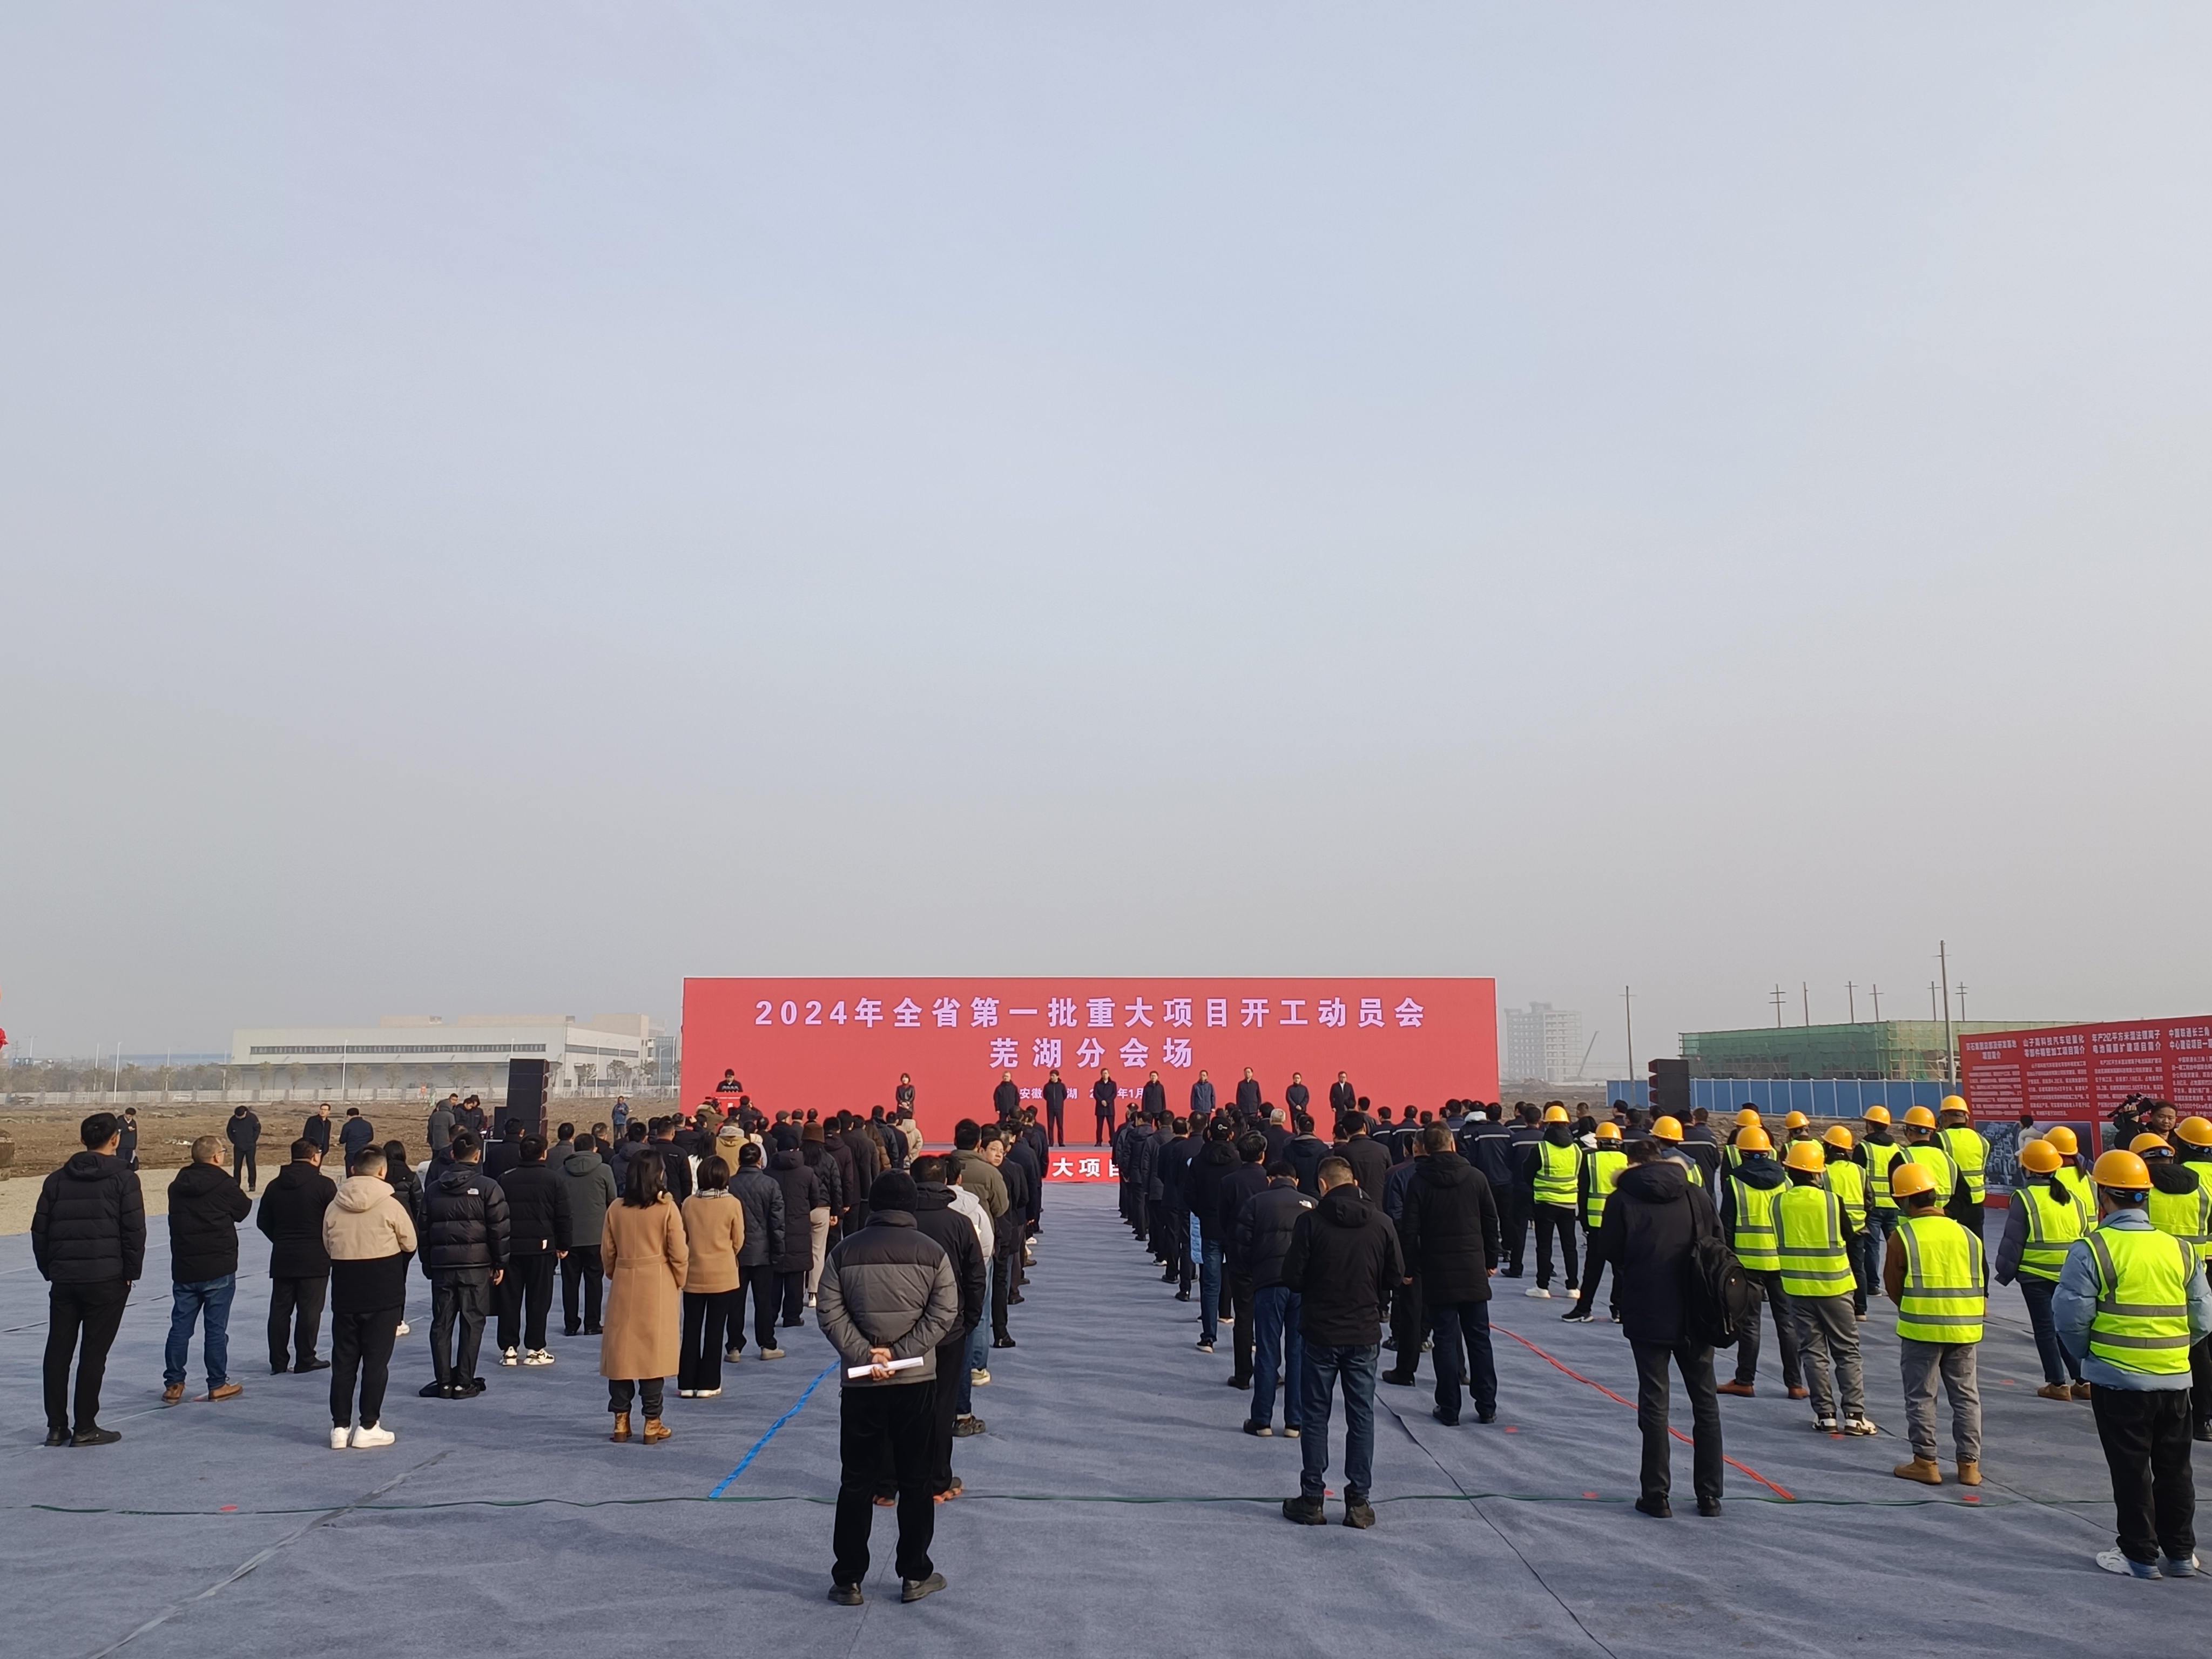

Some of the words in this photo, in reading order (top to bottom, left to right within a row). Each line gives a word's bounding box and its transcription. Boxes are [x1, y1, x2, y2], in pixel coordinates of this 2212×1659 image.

[756, 997, 1424, 1028] 2024年全省第一批重大项目开工动员会
[990, 1037, 1192, 1068] 芜湖分会场
